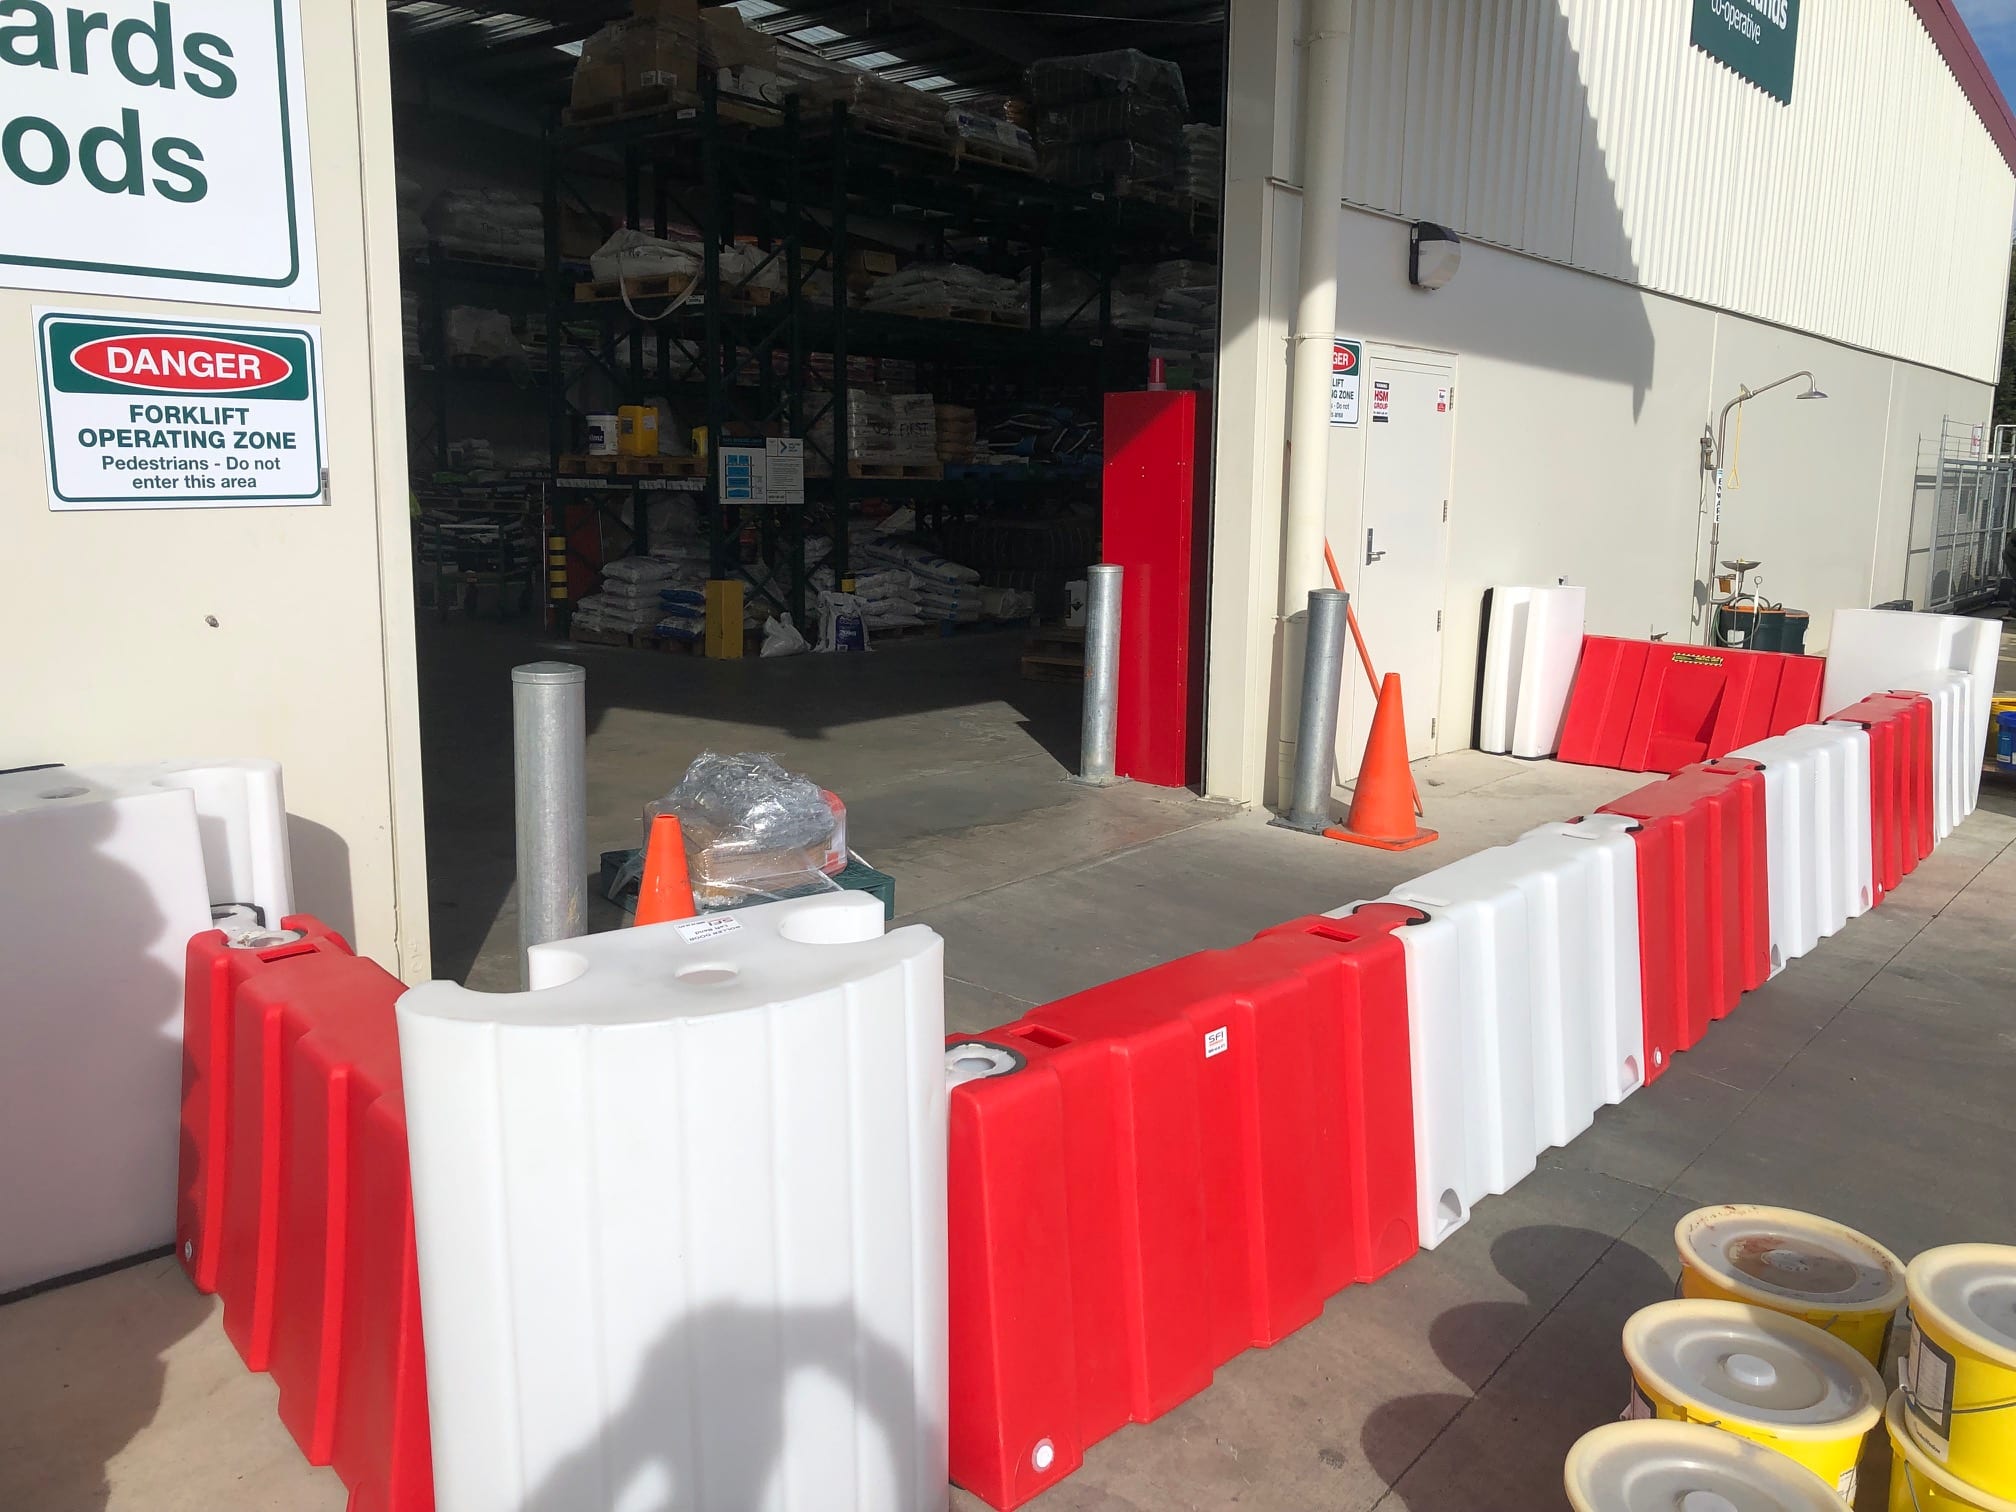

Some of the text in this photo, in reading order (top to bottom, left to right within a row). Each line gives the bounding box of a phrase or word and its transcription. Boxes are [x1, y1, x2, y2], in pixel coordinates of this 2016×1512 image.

[2, 107, 208, 203] ods
[107, 346, 262, 380] DANGER
[1339, 390, 1354, 400] ZONE
[1374, 390, 1389, 402] HSM
[129, 404, 250, 425] FORKLIFT
[78, 428, 297, 449] OPERATING ZONE
[102, 455, 209, 470] Pedestrians
[226, 456, 250, 470] Do
[254, 457, 281, 470] not
[132, 475, 257, 489] enter this area
[1208, 1031, 1224, 1044] SFI
